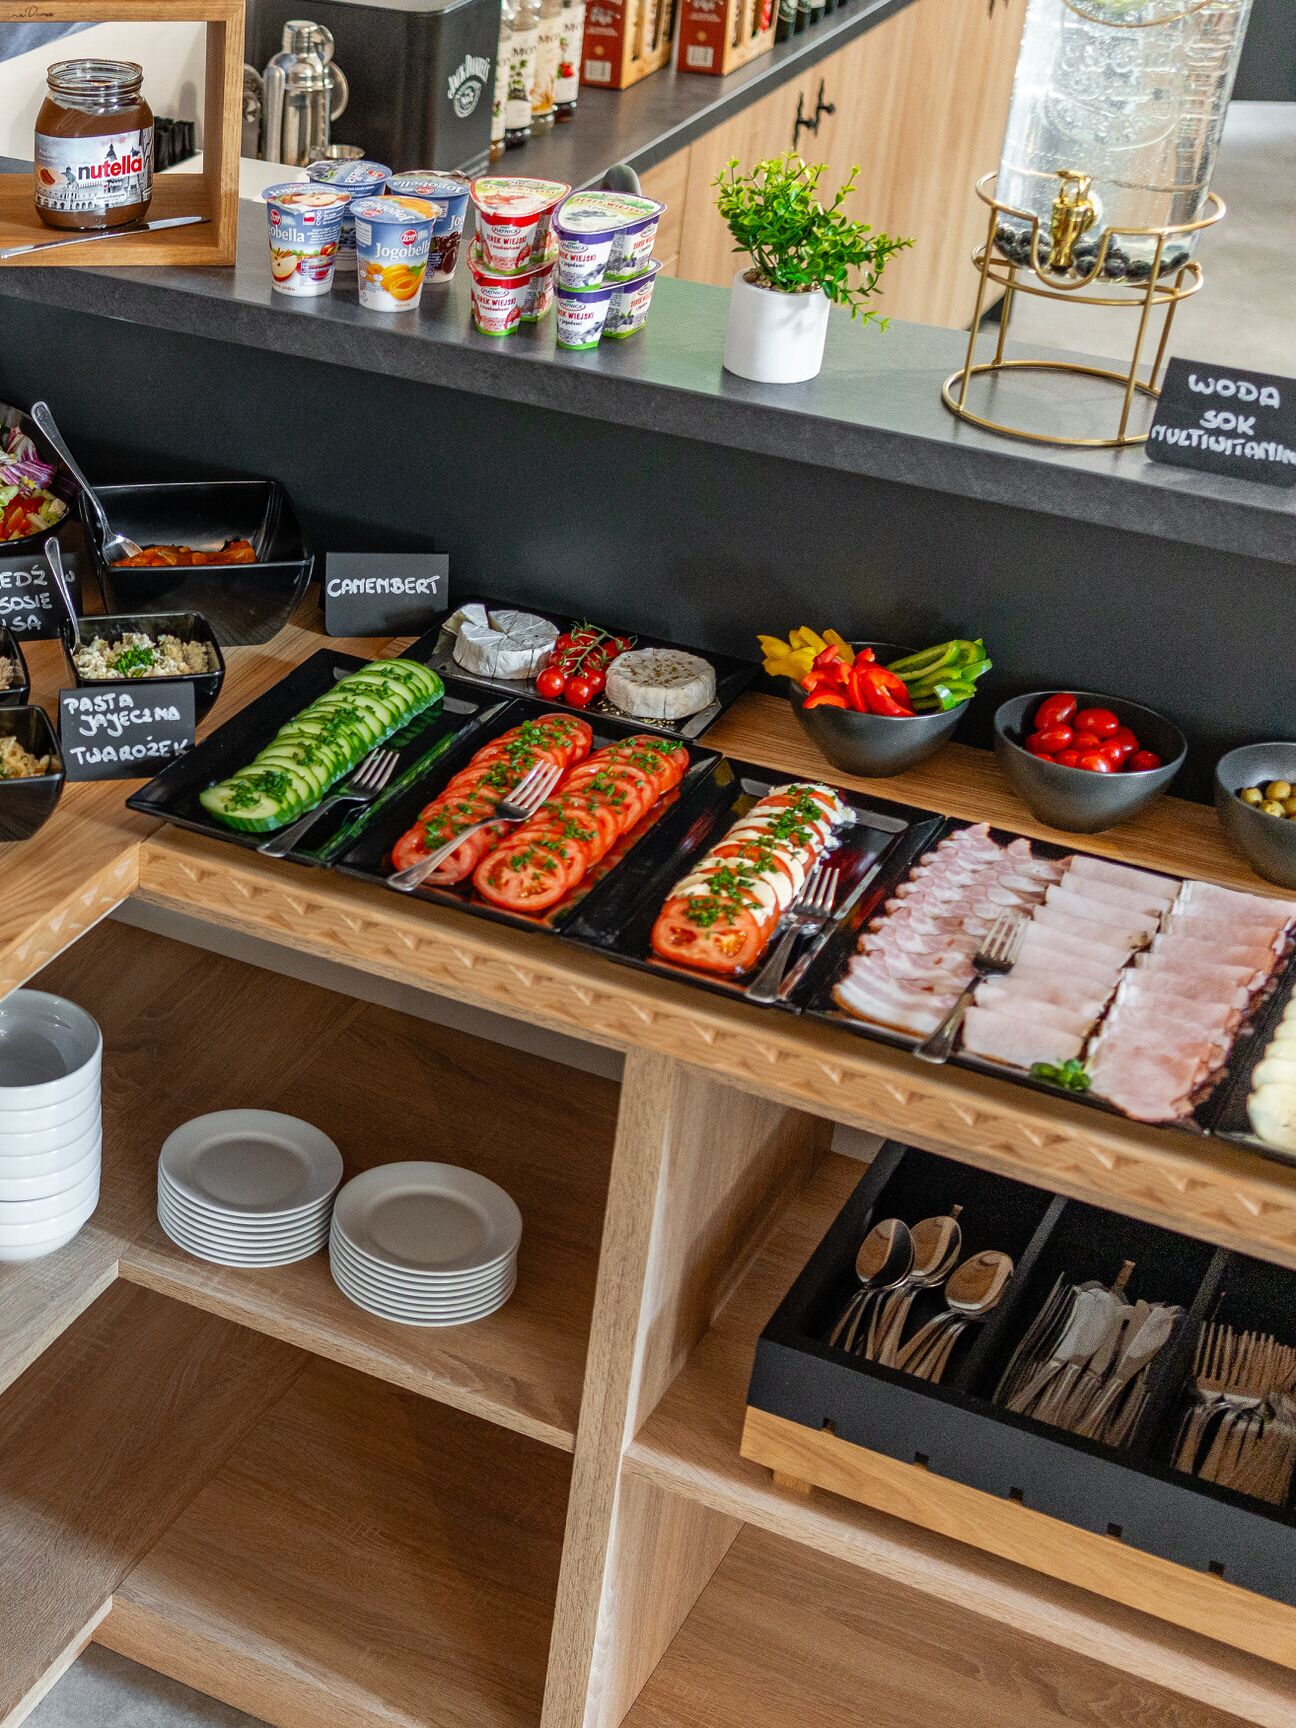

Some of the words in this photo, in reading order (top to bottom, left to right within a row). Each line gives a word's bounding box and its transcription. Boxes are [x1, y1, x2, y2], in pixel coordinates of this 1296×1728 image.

[78, 155, 142, 180] nutella
[269, 225, 305, 242] obella
[1188, 374, 1281, 409] WODA
[1199, 410, 1256, 435] SOK
[327, 575, 441, 598] CAMEMBERT
[63, 693, 135, 715] PASTA
